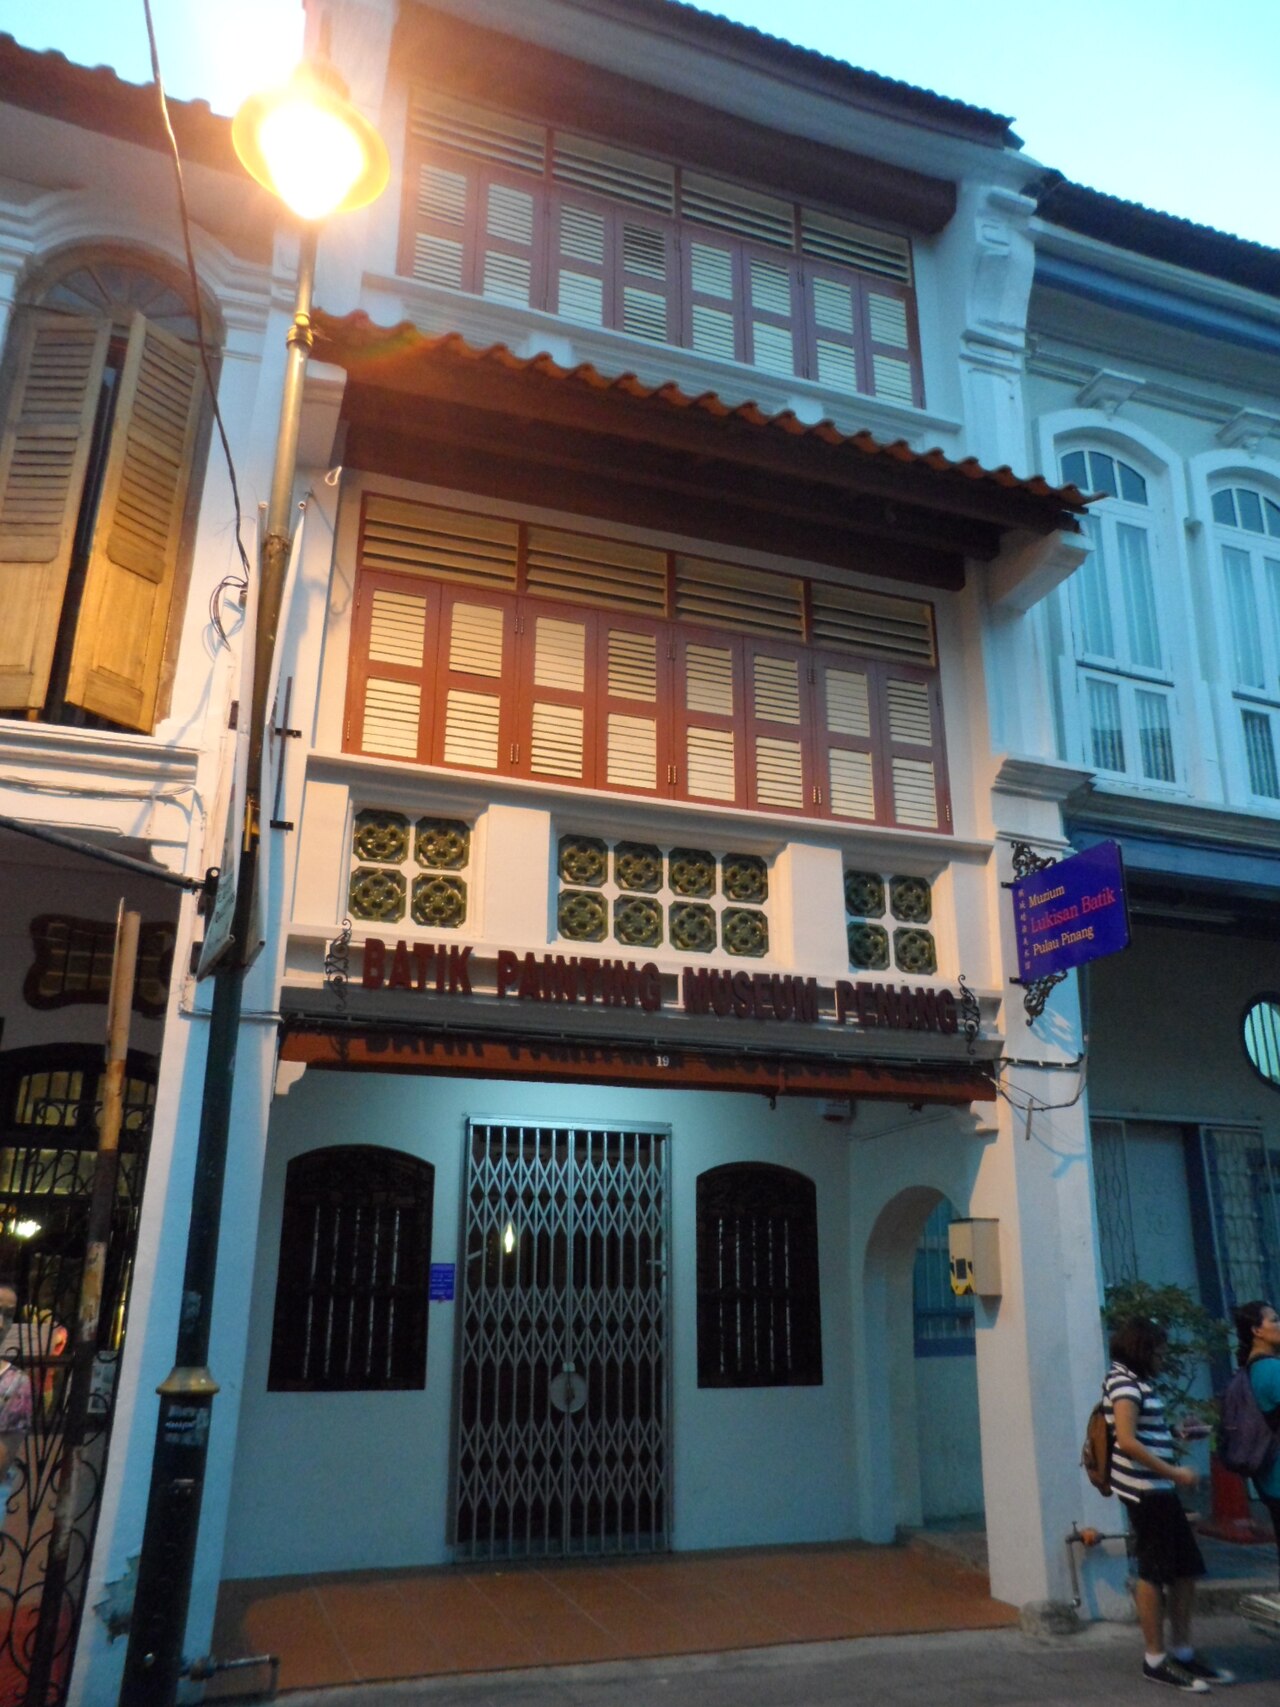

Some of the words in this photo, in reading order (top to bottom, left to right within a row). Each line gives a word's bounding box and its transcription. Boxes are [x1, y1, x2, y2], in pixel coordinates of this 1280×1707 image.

[1028, 885, 1065, 908] Muzium
[1030, 904, 1079, 933] Lukisan
[1081, 887, 1116, 914] Batik
[1033, 936, 1060, 956] Pulau
[1061, 926, 1095, 946] Pinang
[362, 938, 474, 995] BATIK
[497, 950, 661, 1012] PAINTING
[683, 966, 819, 1023] MUSEUM
[835, 980, 959, 1033] PENANG
[656, 1055, 669, 1067] 19
